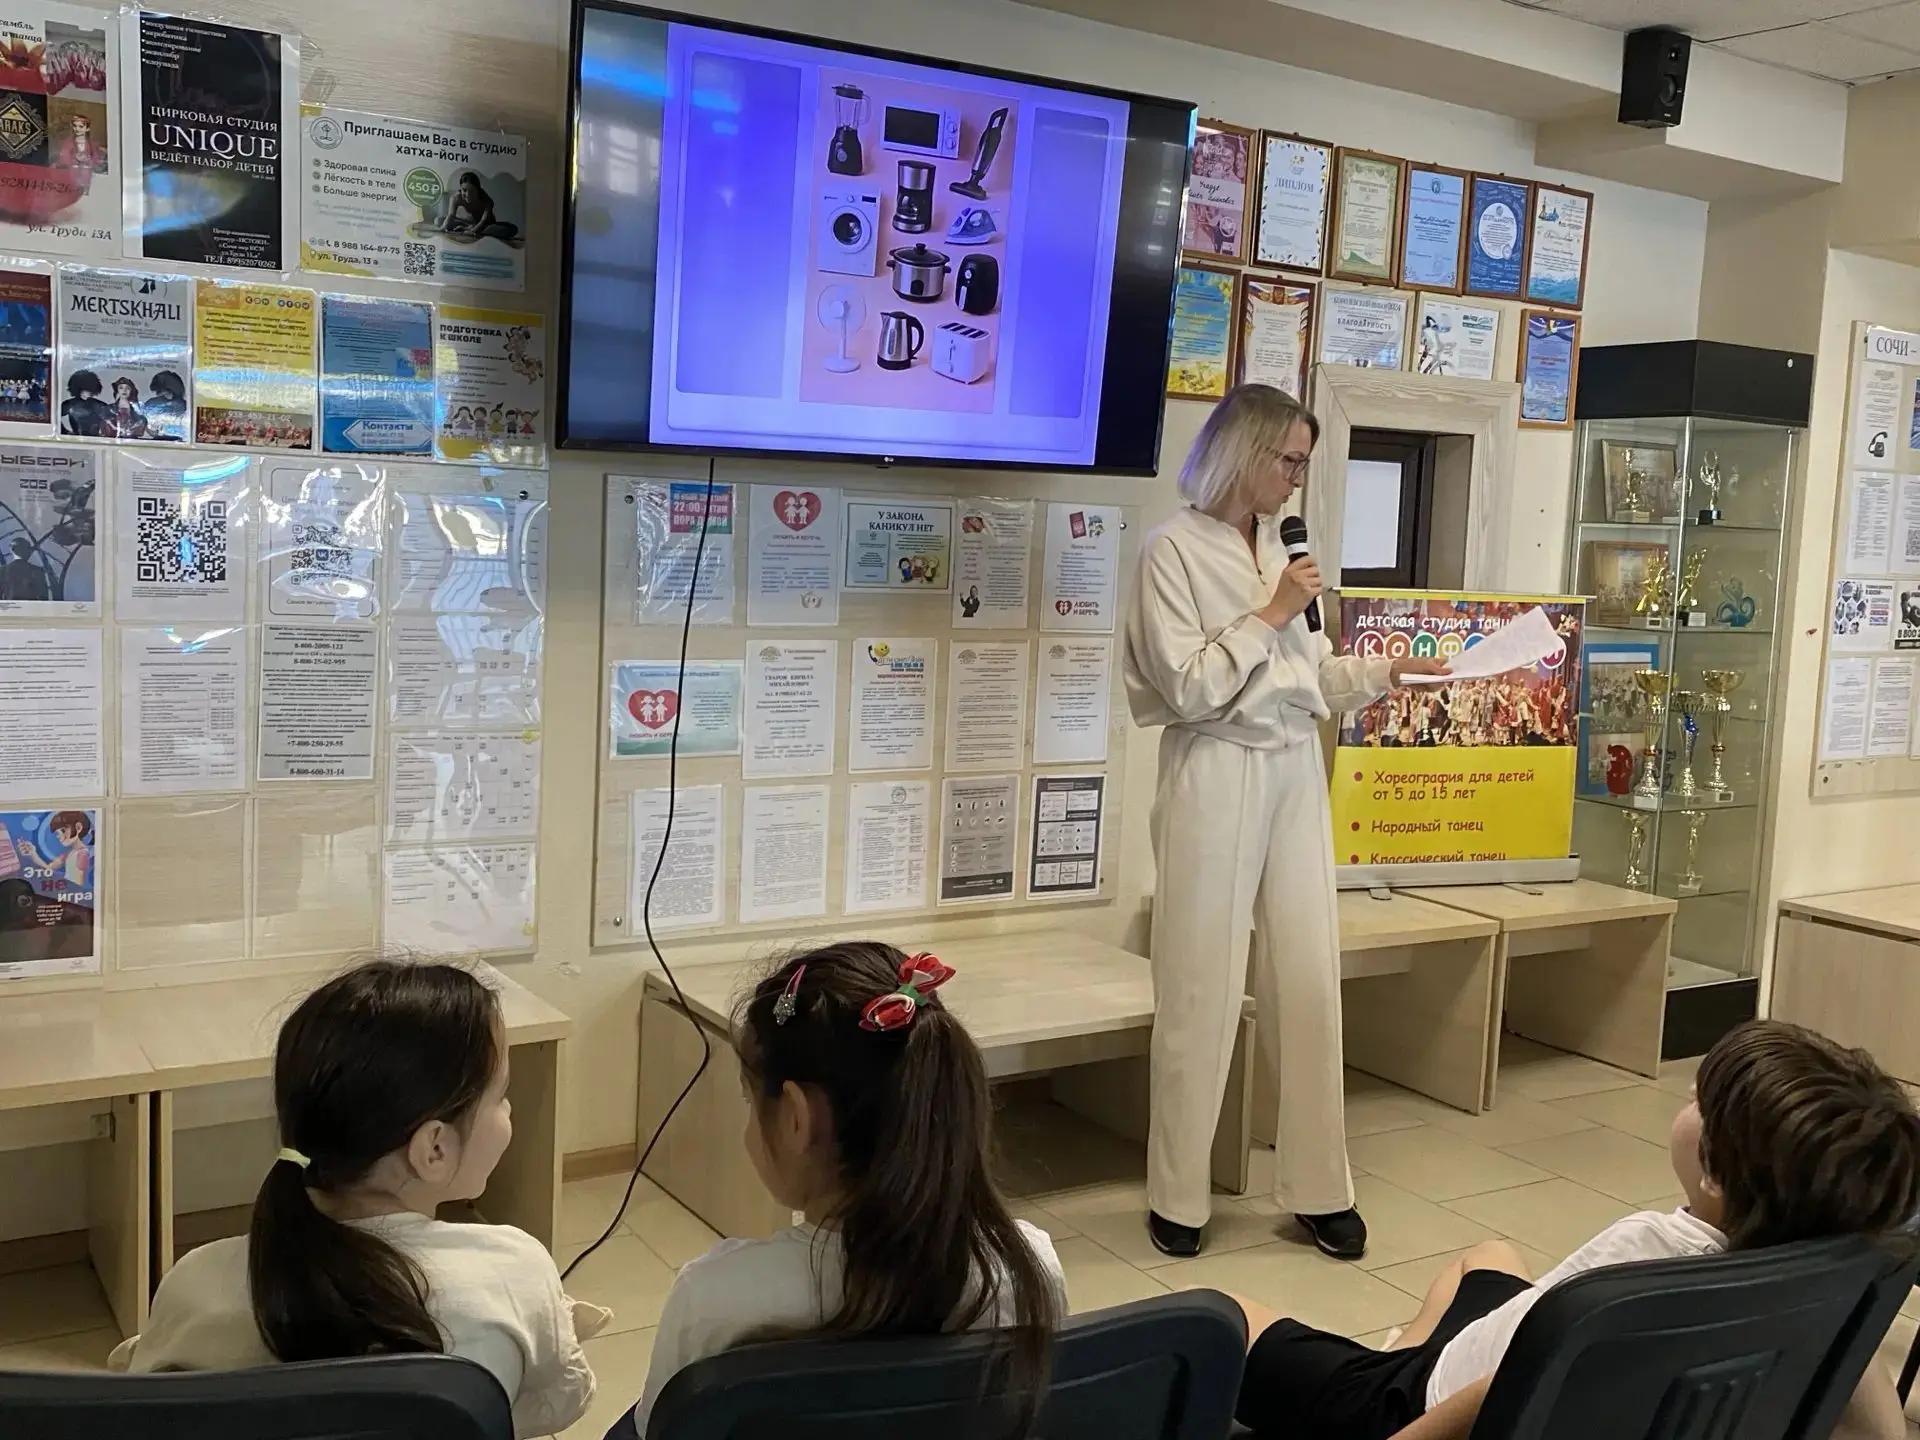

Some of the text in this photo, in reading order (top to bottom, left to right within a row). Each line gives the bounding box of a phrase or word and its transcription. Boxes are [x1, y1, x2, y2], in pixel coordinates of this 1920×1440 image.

[151, 106, 278, 133] ЦИРКОВАЯ СТУДИЯ
[149, 121, 279, 161] UNIQUE
[344, 121, 430, 145] Приглашаем
[433, 133, 456, 148] Вас
[459, 139, 467, 149] в
[469, 142, 518, 157] студию
[395, 143, 469, 164] хатха-йоги
[151, 149, 274, 175] ВЕДЁТ НАБОР ДЕТЕЙ
[324, 159, 397, 177] Здоровая спина
[323, 172, 396, 189] Лёгкость в теле
[408, 181, 430, 193] 450
[1274, 177, 1314, 193] ДИПЛОМ
[323, 185, 359, 198] Больше
[360, 190, 397, 203] энергии
[334, 240, 400, 254] 8 988 164-87-75
[318, 254, 331, 263] ул.
[333, 253, 361, 266] Труда,
[363, 257, 371, 266] 13
[71, 295, 181, 321] MERTSKHALI
[448, 334, 482, 344] ШКОЛЕ
[1876, 336, 1909, 356] СОЧИ
[362, 420, 414, 431] Контакты
[697, 515, 728, 527] ДМОЙ
[878, 511, 924, 522] У ЗАКОНА
[869, 521, 934, 533] КАНИКУЛ НЕТ
[1356, 615, 1415, 628] детская
[1421, 616, 1471, 632] студия
[1373, 769, 1534, 787] Хореография для детей
[1373, 786, 1476, 802] от 5 до 15 лет
[1371, 819, 1484, 837] Народный танец
[1370, 850, 1506, 864] Классический танец
[23, 867, 54, 879] Это
[41, 879, 68, 892] не
[57, 891, 93, 904] игра
